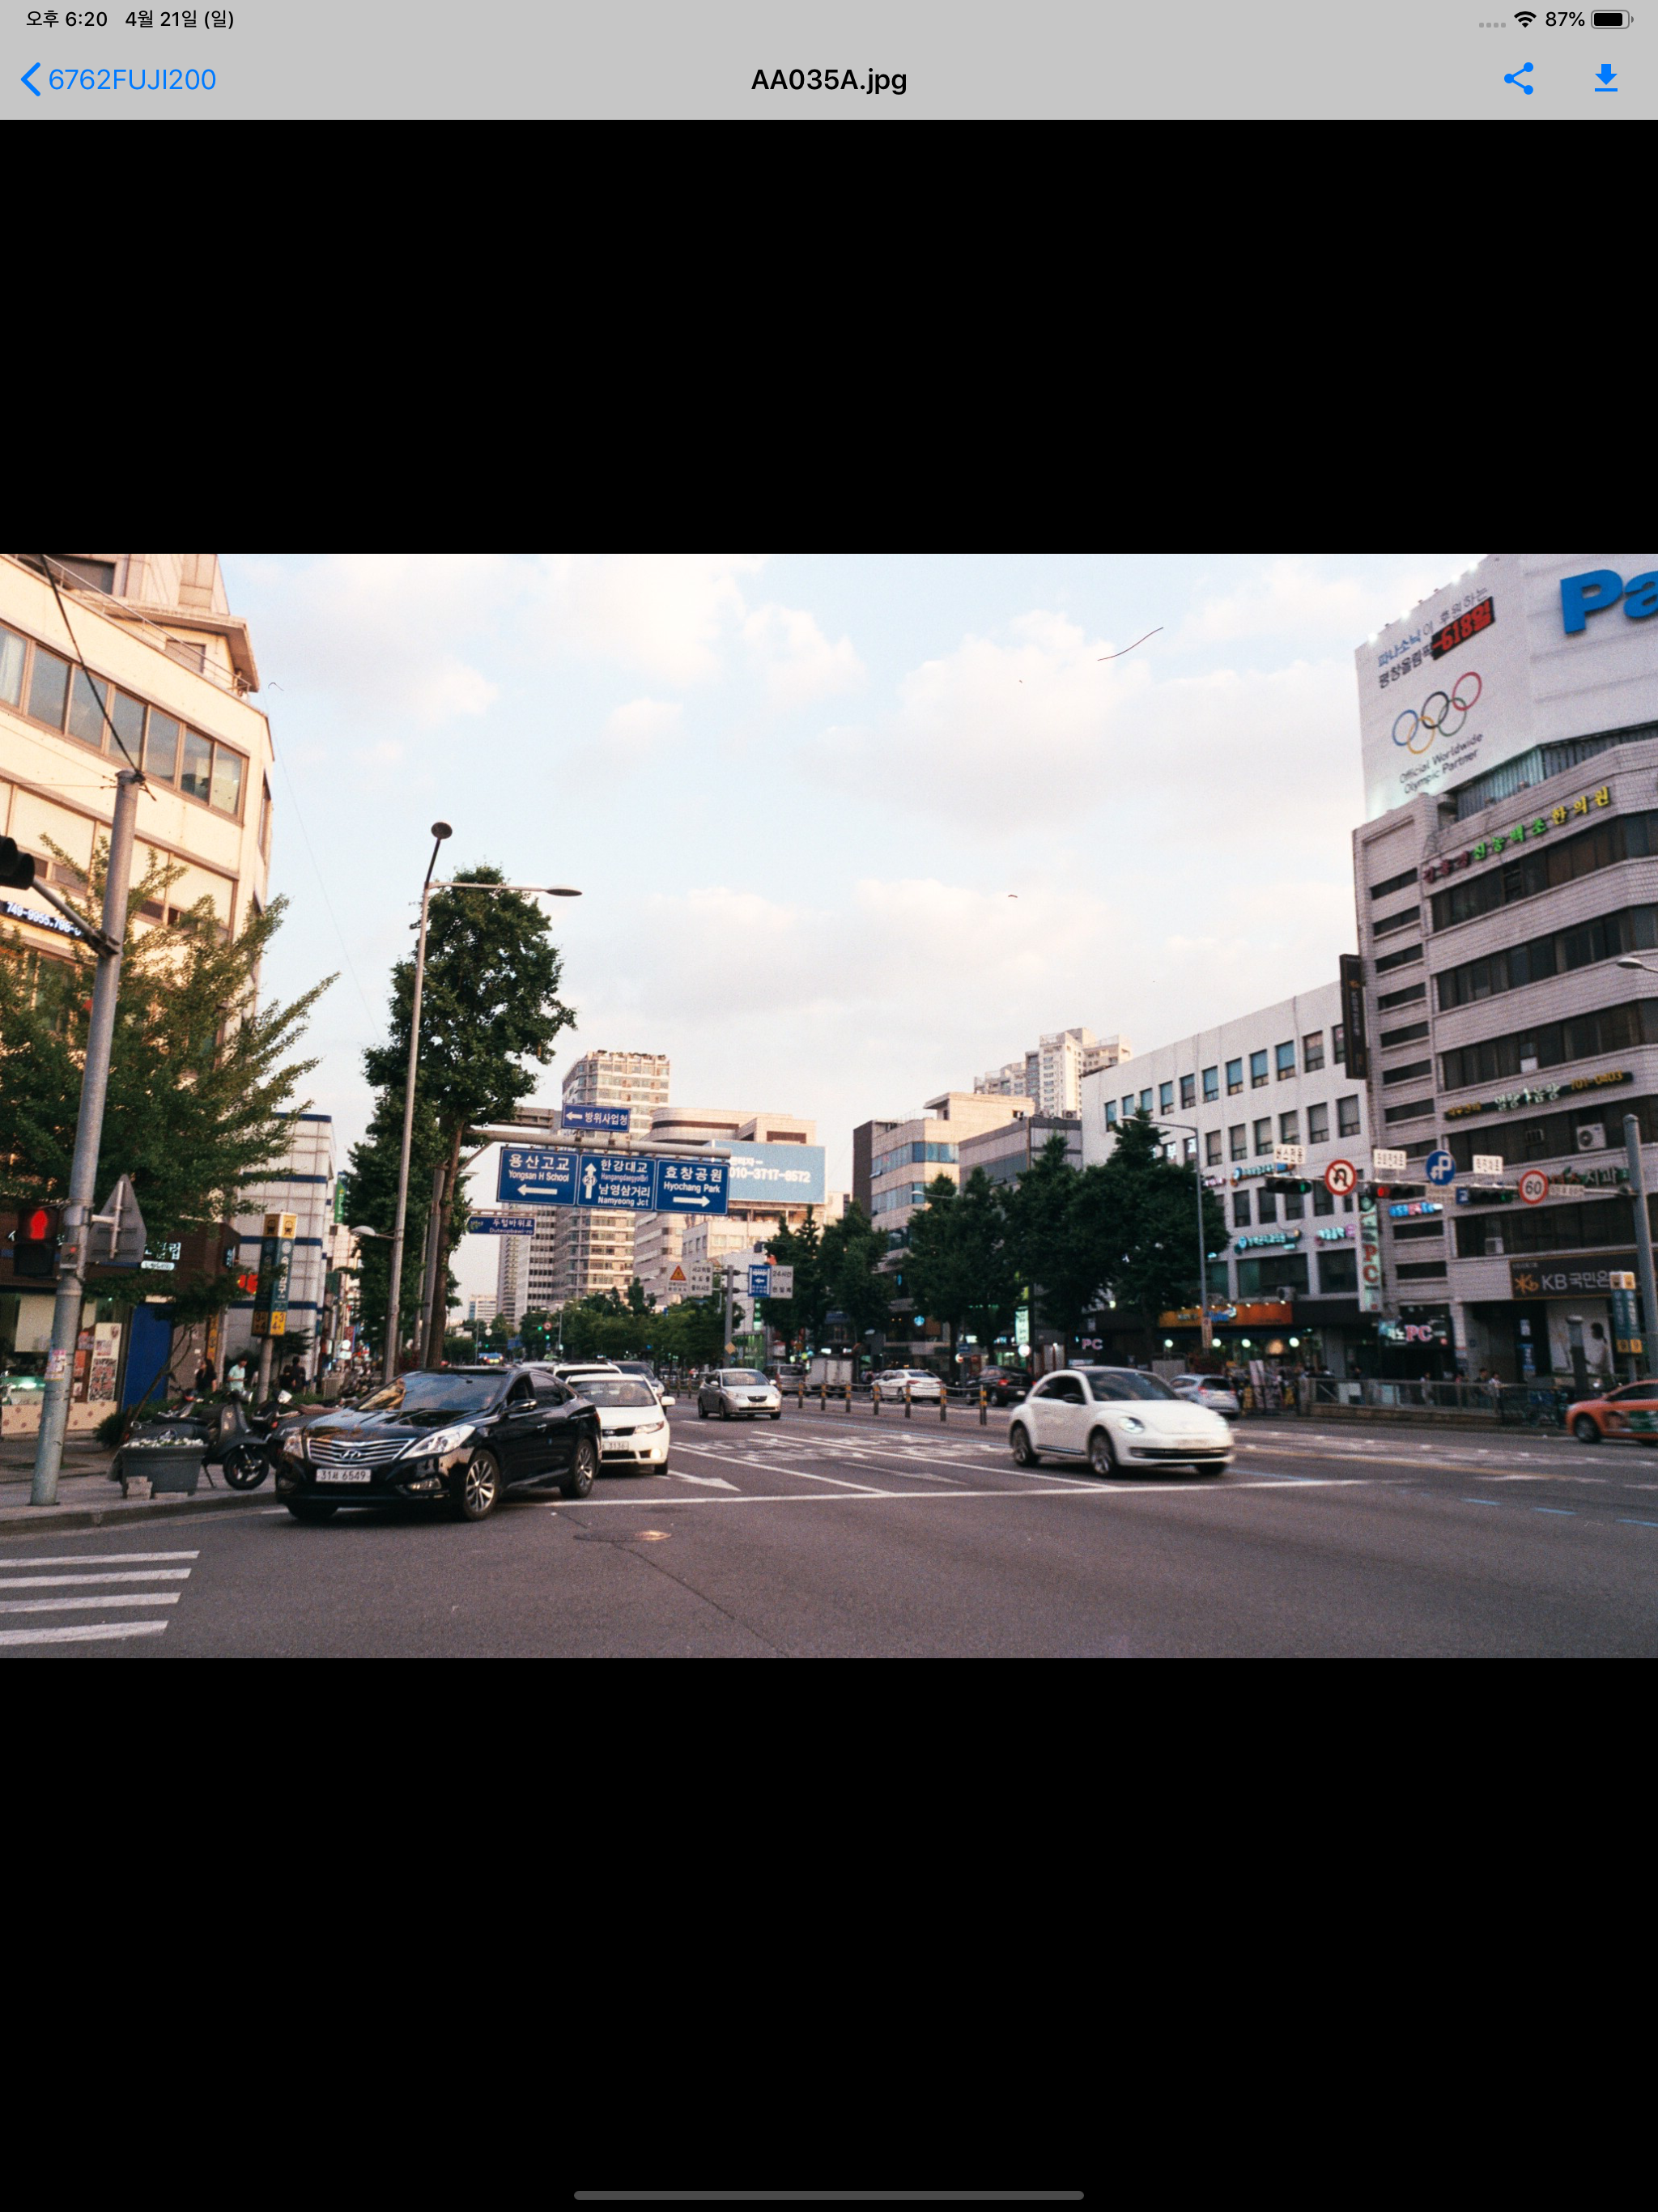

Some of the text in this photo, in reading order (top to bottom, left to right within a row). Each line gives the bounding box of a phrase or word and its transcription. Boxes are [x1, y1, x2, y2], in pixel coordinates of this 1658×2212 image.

[1560, 569, 1658, 634] Pa
[1399, 734, 1483, 783] Official Worldwide
[1405, 749, 1478, 793] Olympic Partner
[585, 1112, 627, 1125] 방위사업청
[509, 1154, 569, 1171] 용산고교
[601, 1159, 648, 1173] 한강대교
[508, 1170, 569, 1182] Yongsan H School
[585, 1176, 594, 1185] 21
[665, 1166, 722, 1182] 효창공원
[598, 1183, 651, 1198] 남영삼거리
[664, 1181, 721, 1194] Hyochang Park
[1525, 1181, 1542, 1195] 60
[597, 1196, 648, 1206] Namyeong Jct
[493, 1219, 533, 1227] 두텁바위로
[1541, 1270, 1609, 1291] KB 국민은
[279, 1313, 284, 1323] 3
[1405, 1324, 1434, 1342] PC
[1082, 1338, 1103, 1351] PC
